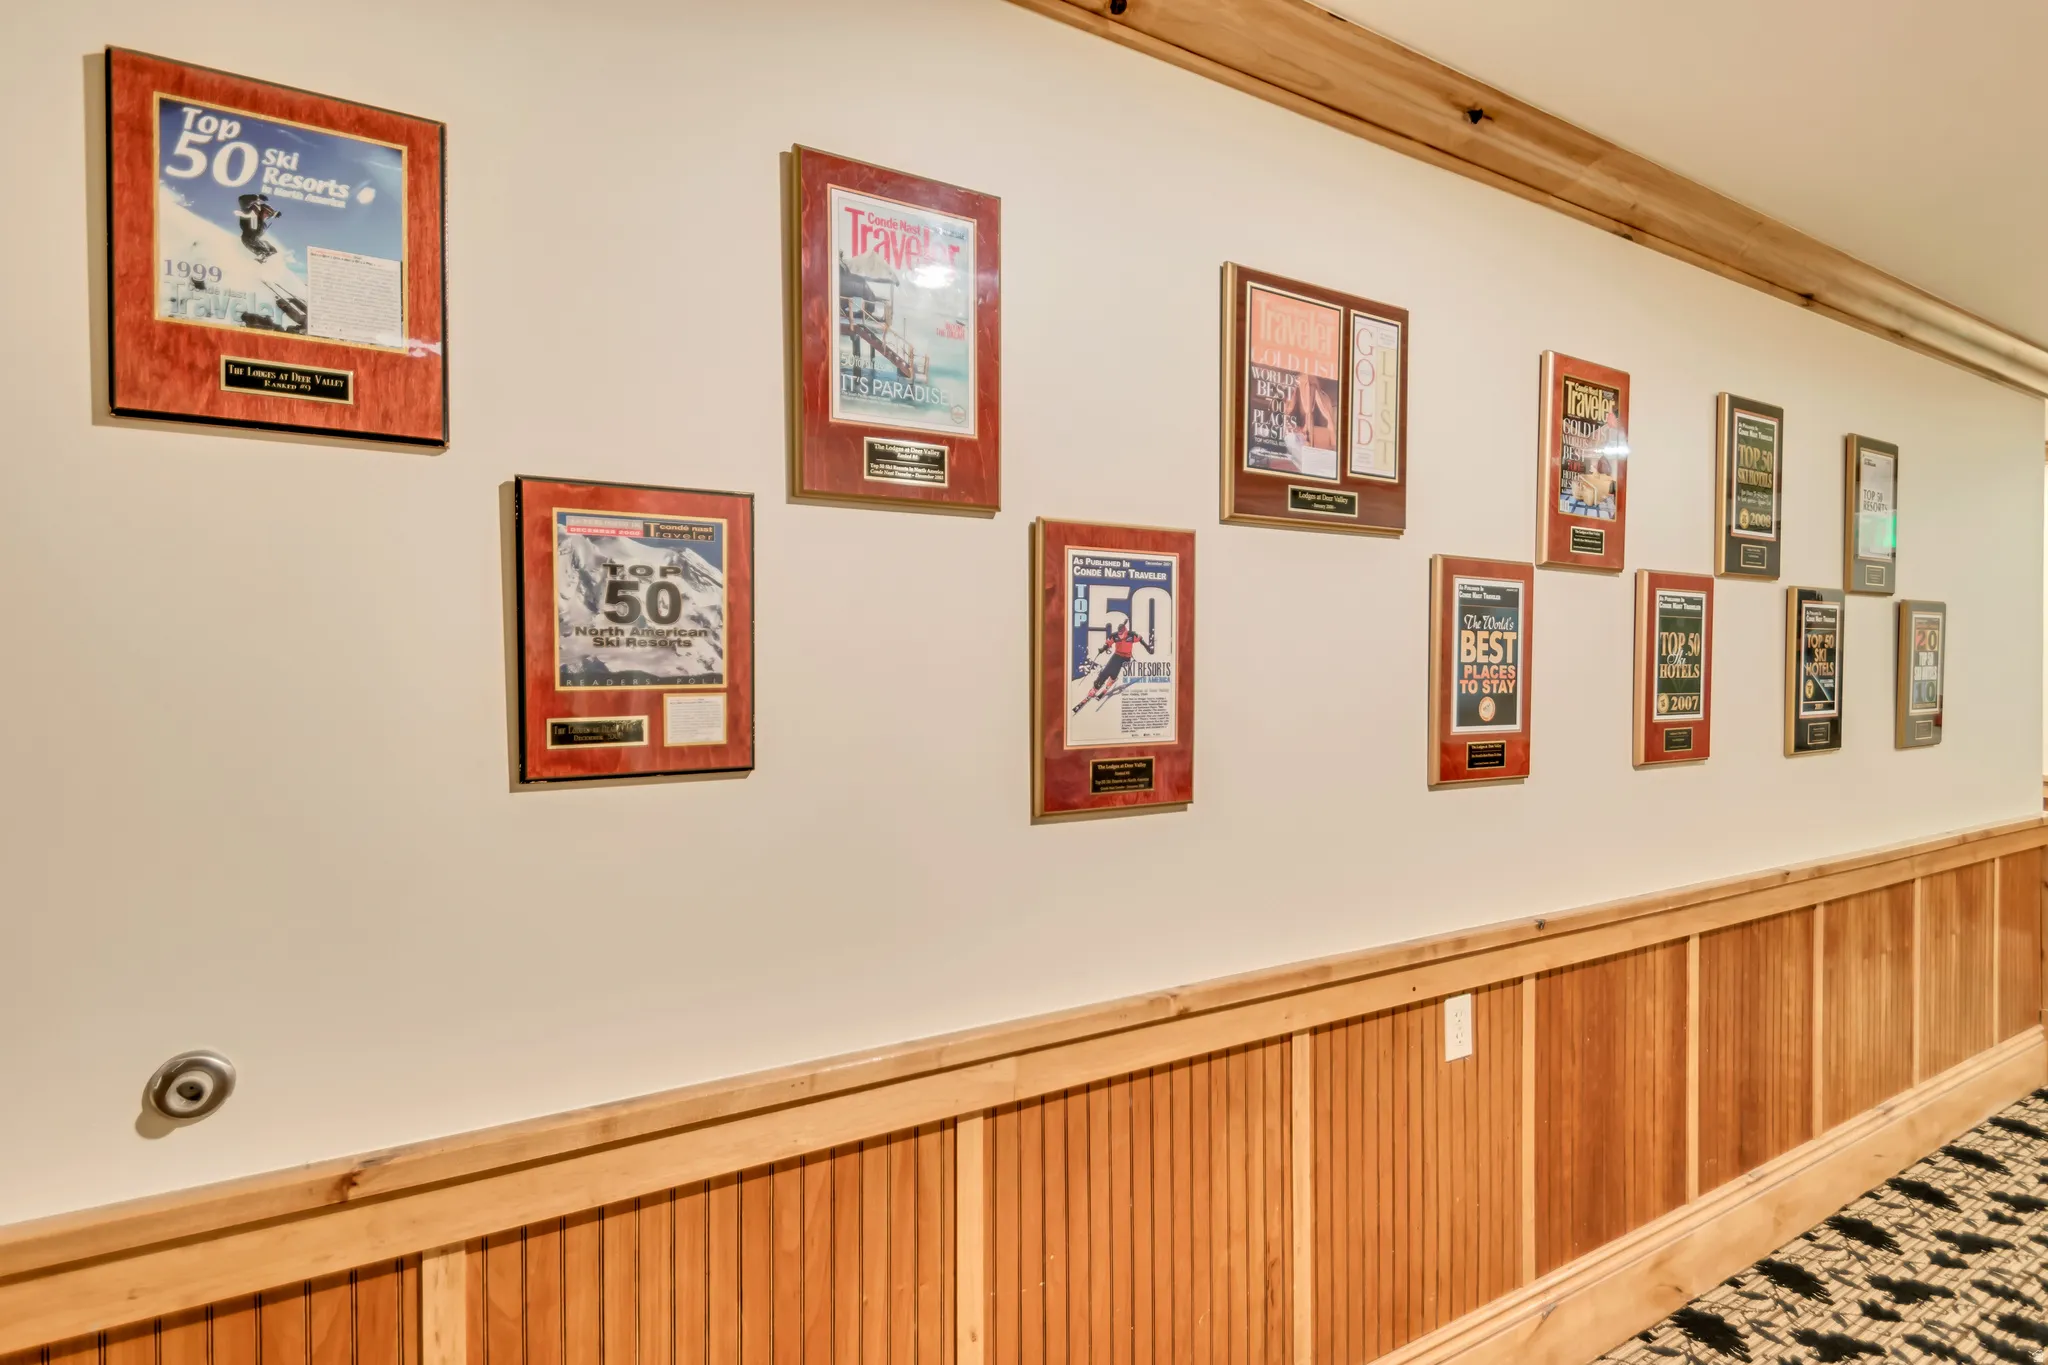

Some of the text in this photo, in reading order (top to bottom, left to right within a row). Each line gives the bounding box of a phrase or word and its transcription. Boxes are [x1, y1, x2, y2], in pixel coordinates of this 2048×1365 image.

[182, 107, 241, 141] Top
[165, 131, 259, 187] 50
[262, 149, 299, 171] Ski
[263, 166, 350, 199] Resorts
[900, 220, 920, 236] Nast
[164, 259, 222, 282] 1999
[1256, 296, 1336, 356] Traveler
[1252, 366, 1301, 386] WORLD'S
[841, 374, 869, 394] IT'S
[872, 378, 950, 405] PARADISE
[1257, 380, 1296, 400] BEST
[1566, 380, 1616, 422] Traveler
[1252, 409, 1297, 430] PLACES
[1563, 418, 1591, 438] GOLD
[886, 444, 904, 452] Lodges
[1564, 445, 1584, 462] BEST
[1738, 444, 1760, 470] TOP
[1299, 492, 1316, 500] Lodges
[1322, 494, 1334, 502] Deer
[1334, 496, 1348, 504] Valley
[570, 527, 616, 535] DECEMBER
[644, 522, 712, 540] Traveler
[660, 524, 689, 532] condé
[602, 562, 682, 578] TOP
[1104, 568, 1126, 578] NAST
[1128, 569, 1166, 580] TRAVELER
[604, 580, 682, 626] 50
[1074, 584, 1088, 628] TOP
[1088, 585, 1172, 656] 50
[1464, 614, 1514, 630] The World's
[574, 626, 708, 638] North American
[592, 637, 692, 648] Ski Resorts
[1460, 630, 1517, 664] BEST
[1660, 632, 1700, 656] TOP 50
[1808, 634, 1834, 648] TOP 50
[1814, 648, 1826, 662] SKI
[1122, 662, 1171, 676] SKI RESORTS
[1464, 664, 1516, 680] PLACES
[1660, 664, 1700, 678] HOTELS
[1806, 662, 1834, 676] HOTELS
[676, 678, 719, 686] POLL
[1460, 680, 1516, 694] TO STAY
[1670, 696, 1699, 710] 2007
